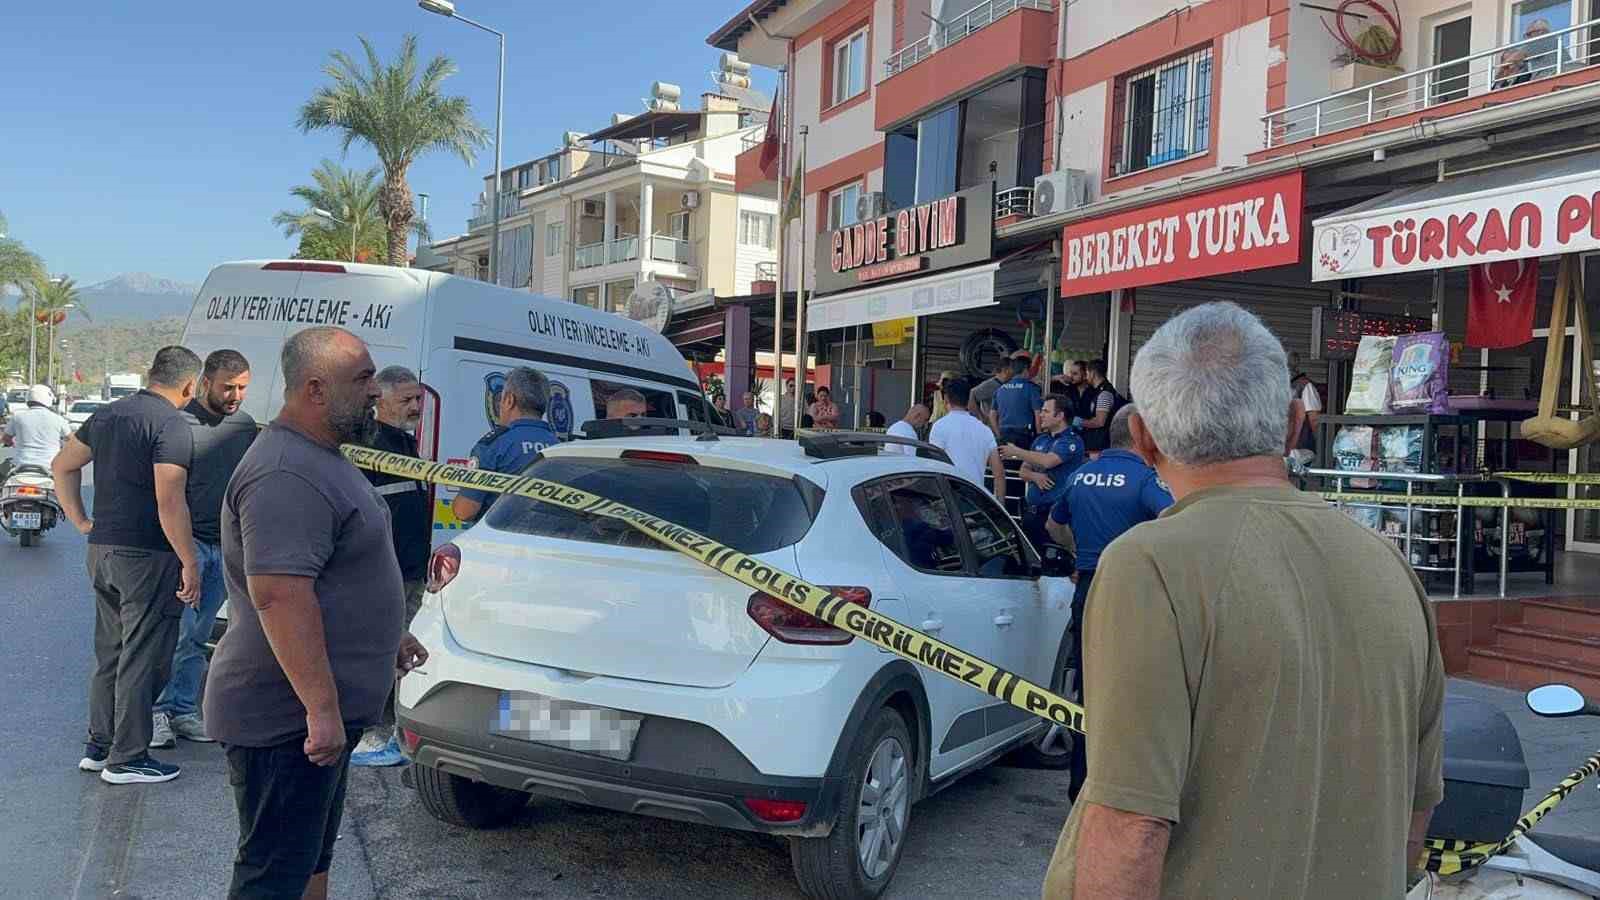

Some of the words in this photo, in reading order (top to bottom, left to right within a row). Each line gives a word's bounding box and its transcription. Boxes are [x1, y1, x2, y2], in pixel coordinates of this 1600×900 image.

[831, 216, 888, 273] CADDE
[896, 197, 958, 256] GİYİM
[1066, 216, 1180, 280] BEREKET
[1185, 193, 1290, 259] YUFKA
[1366, 202, 1542, 268] TÜRKAN
[206, 296, 241, 320] OLAY
[242, 296, 273, 321] YERİ
[273, 297, 350, 325] İNCELEME
[361, 303, 393, 329] AKİ
[528, 310, 557, 337] OLAY
[1073, 472, 1126, 487] POLİS
[440, 466, 507, 490] GİRİLMEZ
[525, 479, 585, 506] POLİS
[734, 557, 811, 604] POLİS
[844, 609, 985, 688] GİRİLMEZ
